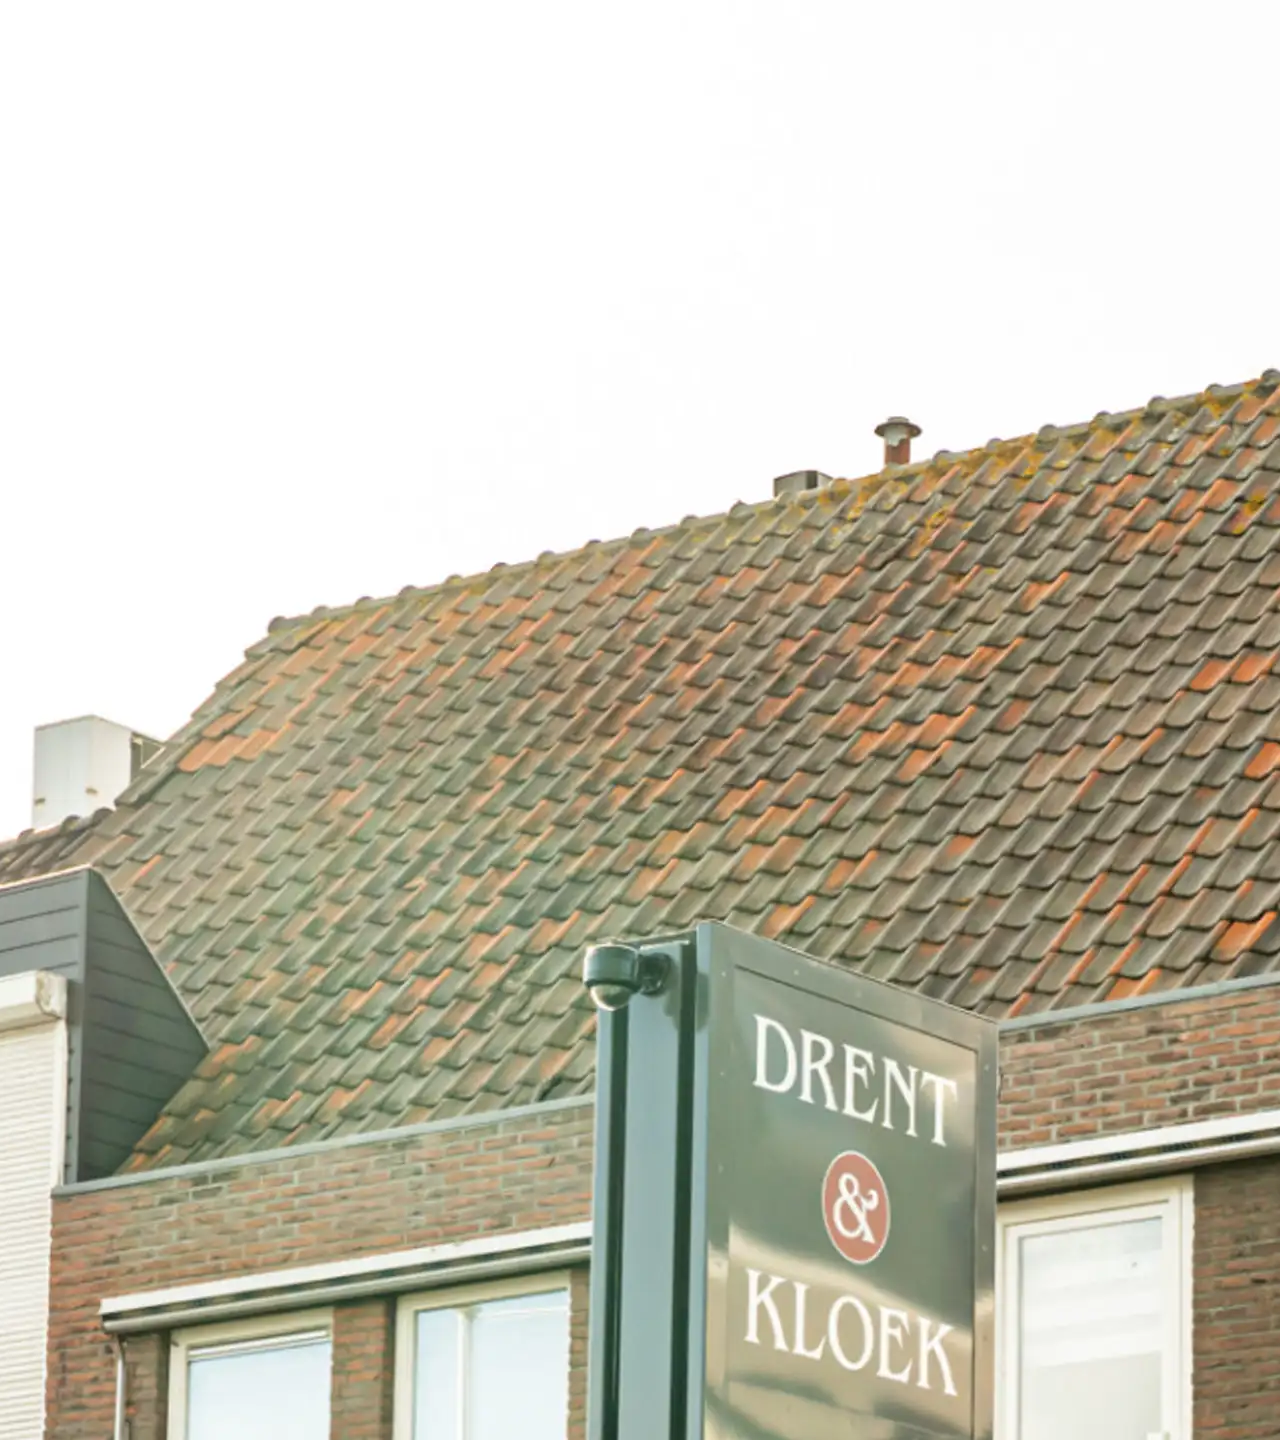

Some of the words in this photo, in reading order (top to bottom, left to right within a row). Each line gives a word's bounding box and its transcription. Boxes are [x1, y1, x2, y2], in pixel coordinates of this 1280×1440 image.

[751, 1014, 959, 1147] DRENT
[832, 1173, 880, 1245] &
[744, 1268, 960, 1397] KLOEK
